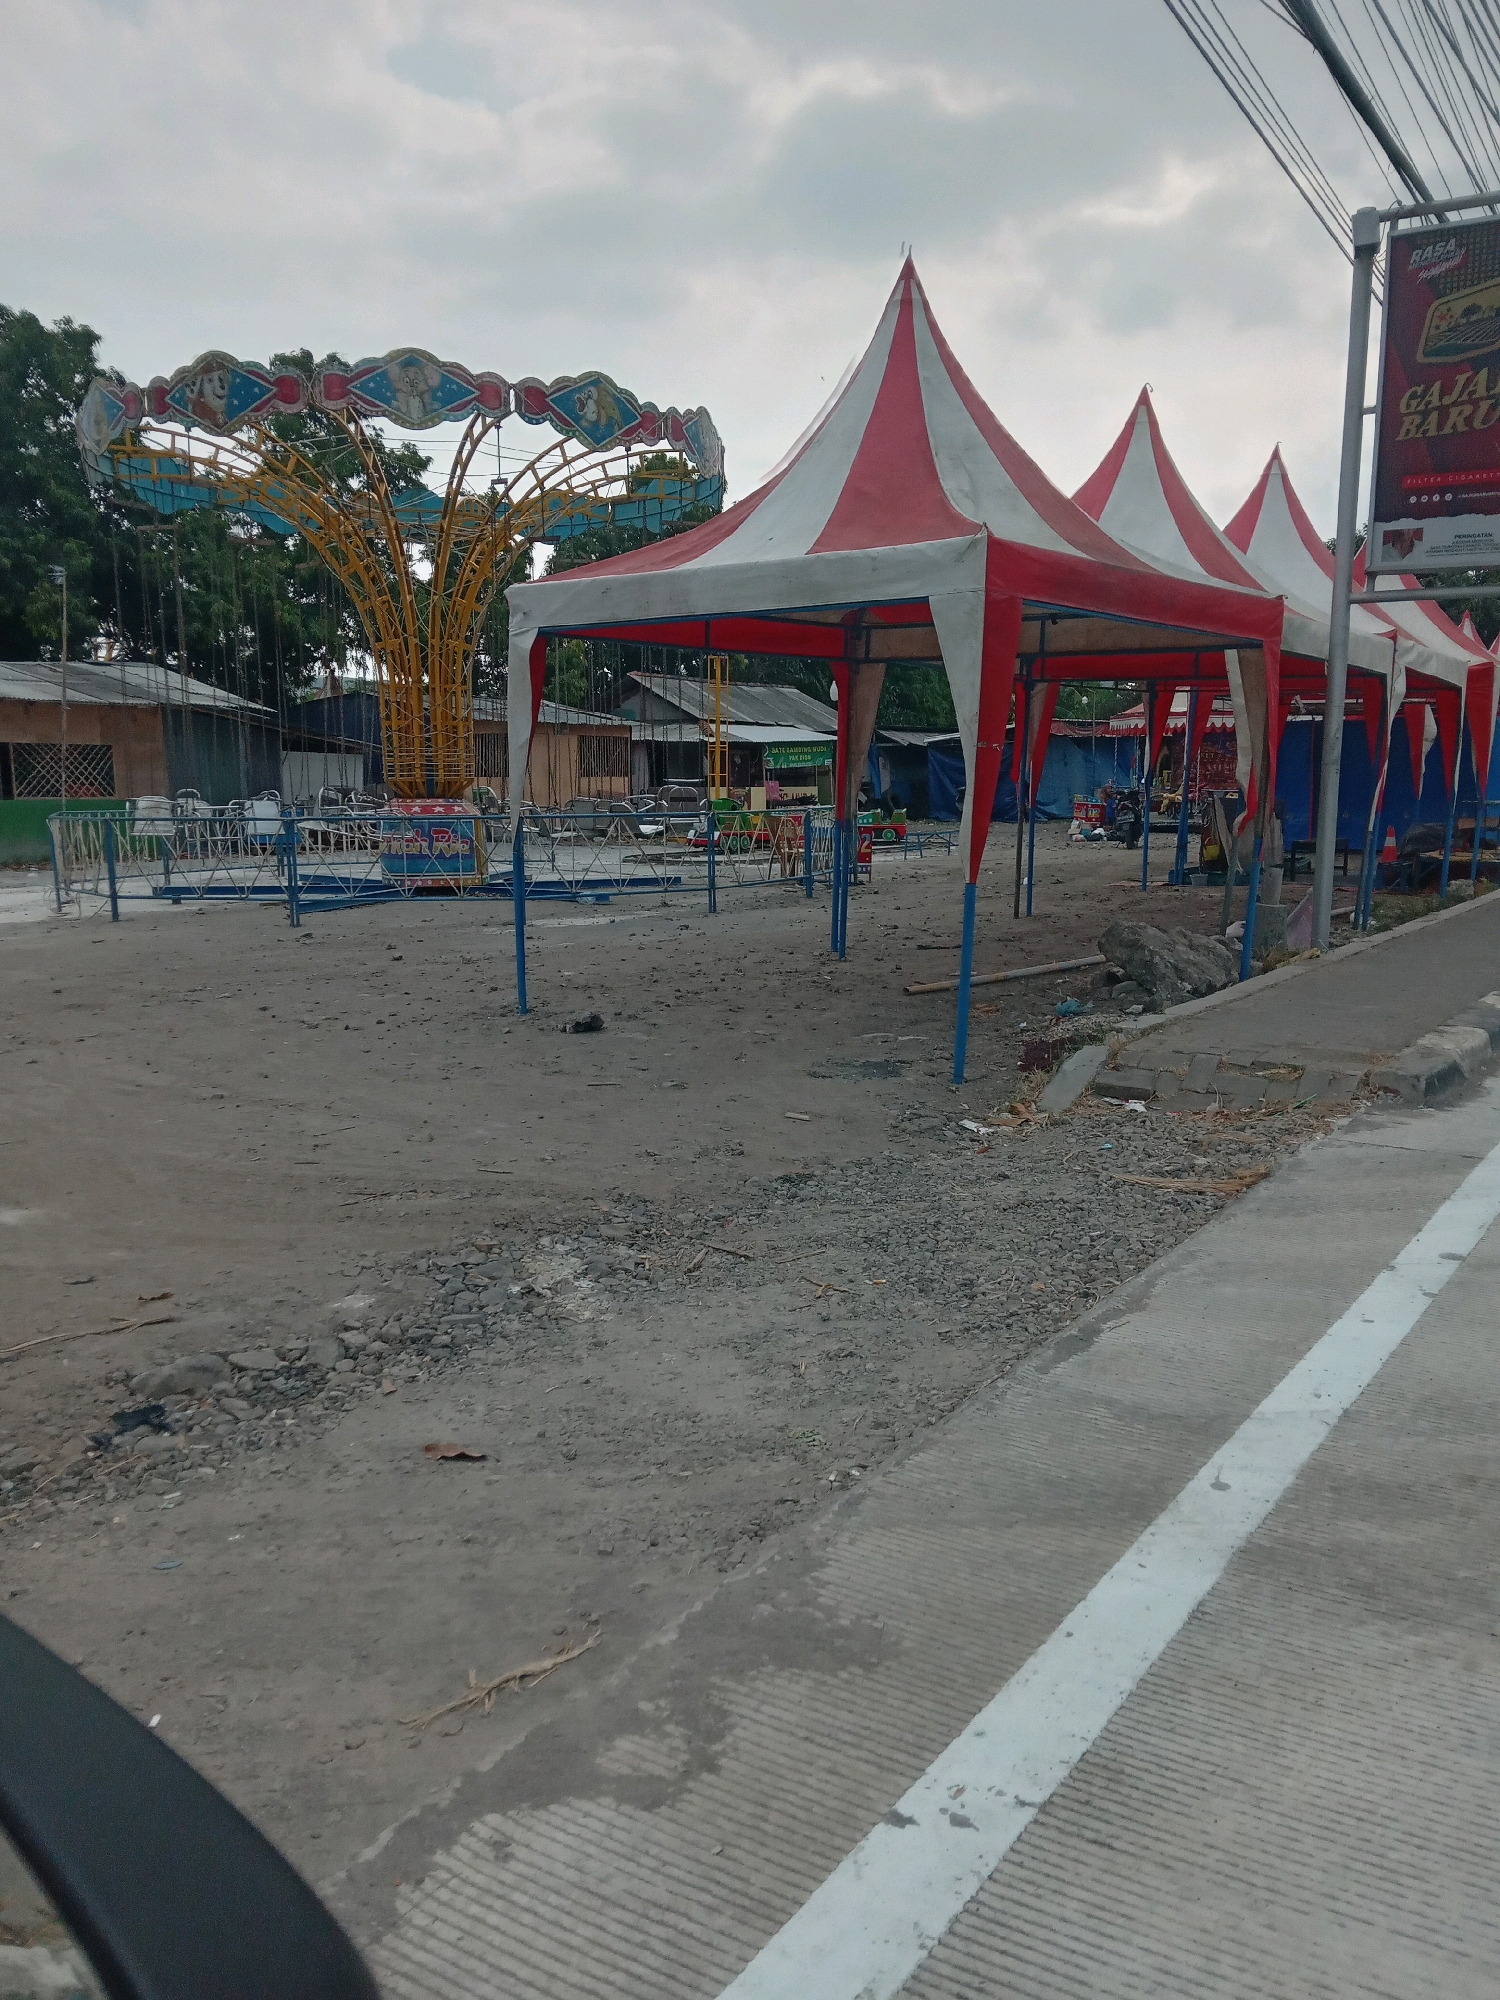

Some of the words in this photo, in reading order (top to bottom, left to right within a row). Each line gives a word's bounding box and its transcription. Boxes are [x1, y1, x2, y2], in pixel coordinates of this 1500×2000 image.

[1410, 238, 1456, 264] RASA
[1395, 399, 1500, 440] BARU
[431, 828, 470, 858] Ria
